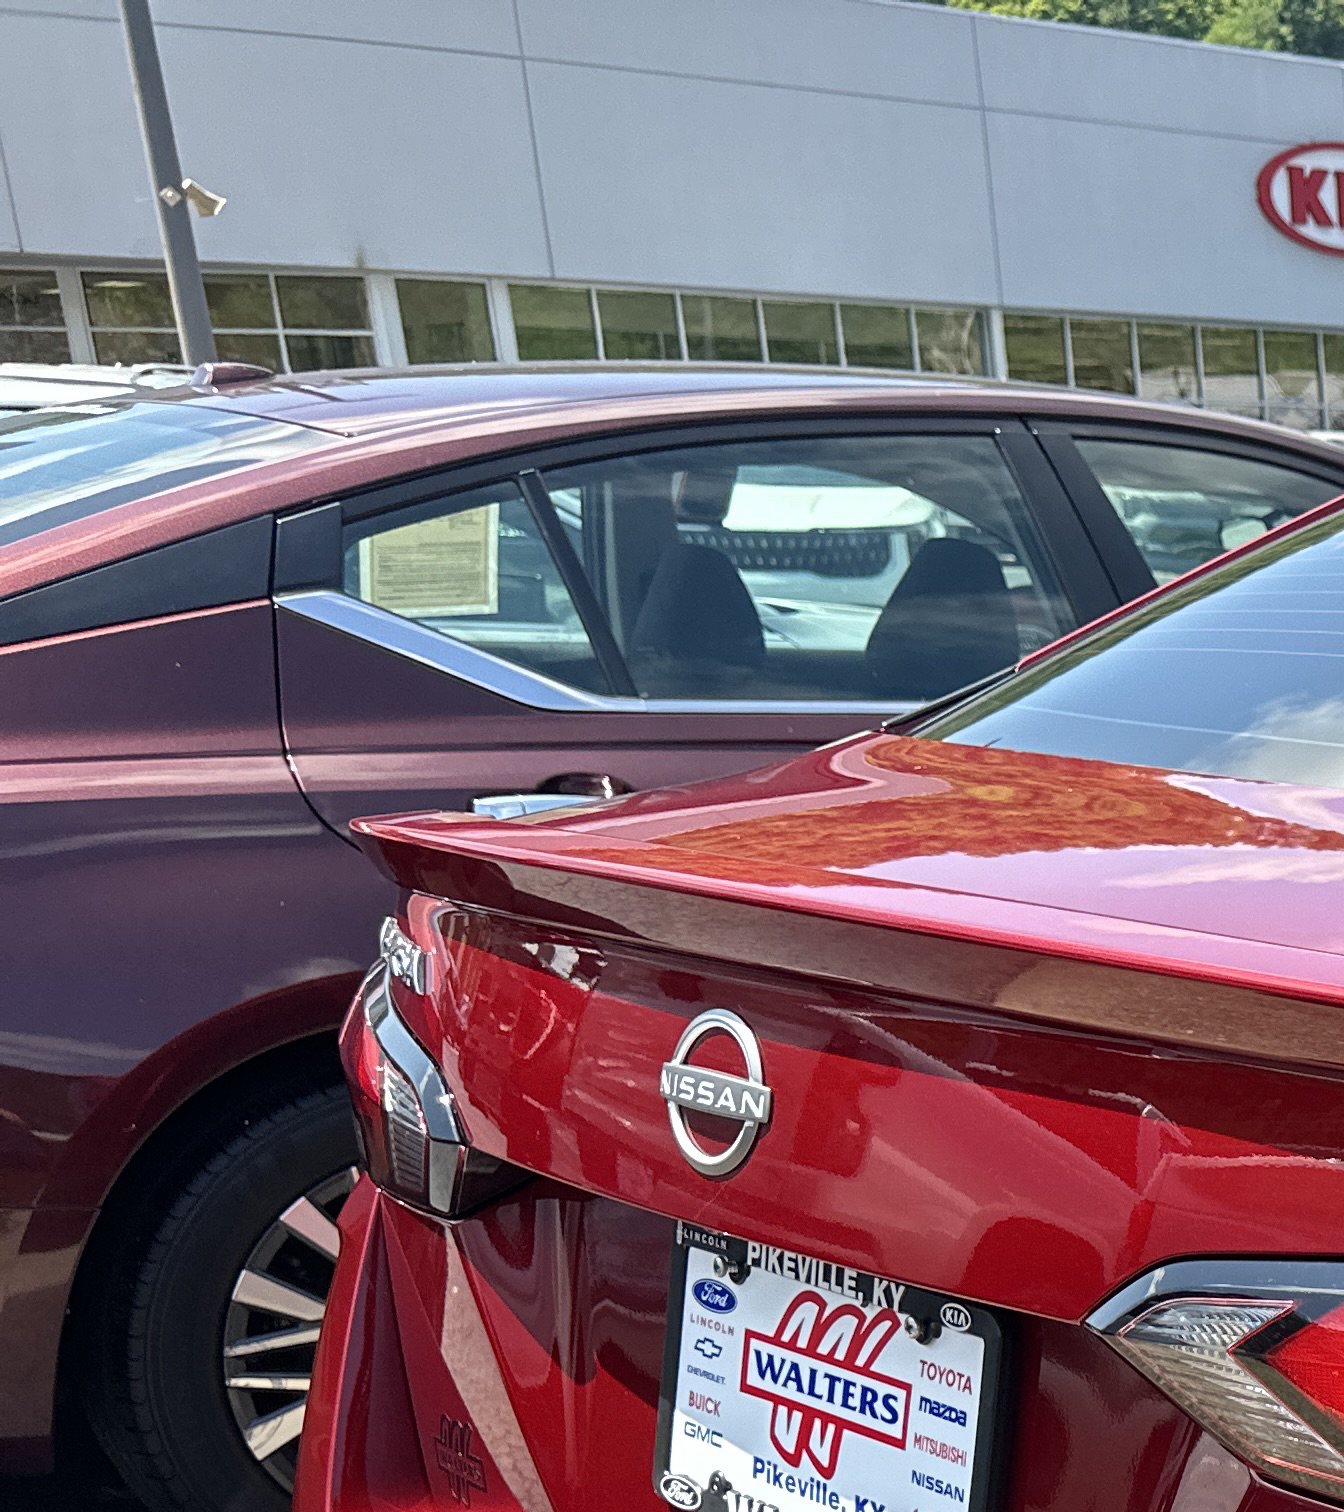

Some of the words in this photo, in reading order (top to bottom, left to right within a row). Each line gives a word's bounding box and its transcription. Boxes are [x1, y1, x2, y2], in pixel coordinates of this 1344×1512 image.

[660, 1071, 765, 1119] NISSAN
[683, 1227, 728, 1250] LINCOLN
[747, 1242, 864, 1306] PIKEVILLE,
[873, 1276, 906, 1312] KY
[700, 1281, 730, 1308] Ford
[689, 1313, 735, 1336] LINCOLN
[945, 1307, 966, 1327] KIA
[753, 1348, 899, 1426] WALTERS
[919, 1359, 973, 1395] TOYOTA
[688, 1390, 721, 1417] BUICK
[919, 1395, 967, 1427] mazda
[684, 1421, 723, 1448] GMC
[913, 1432, 967, 1466] MITSUBISHI
[666, 1477, 694, 1505] Ford
[911, 1469, 965, 1503] NISSAN
